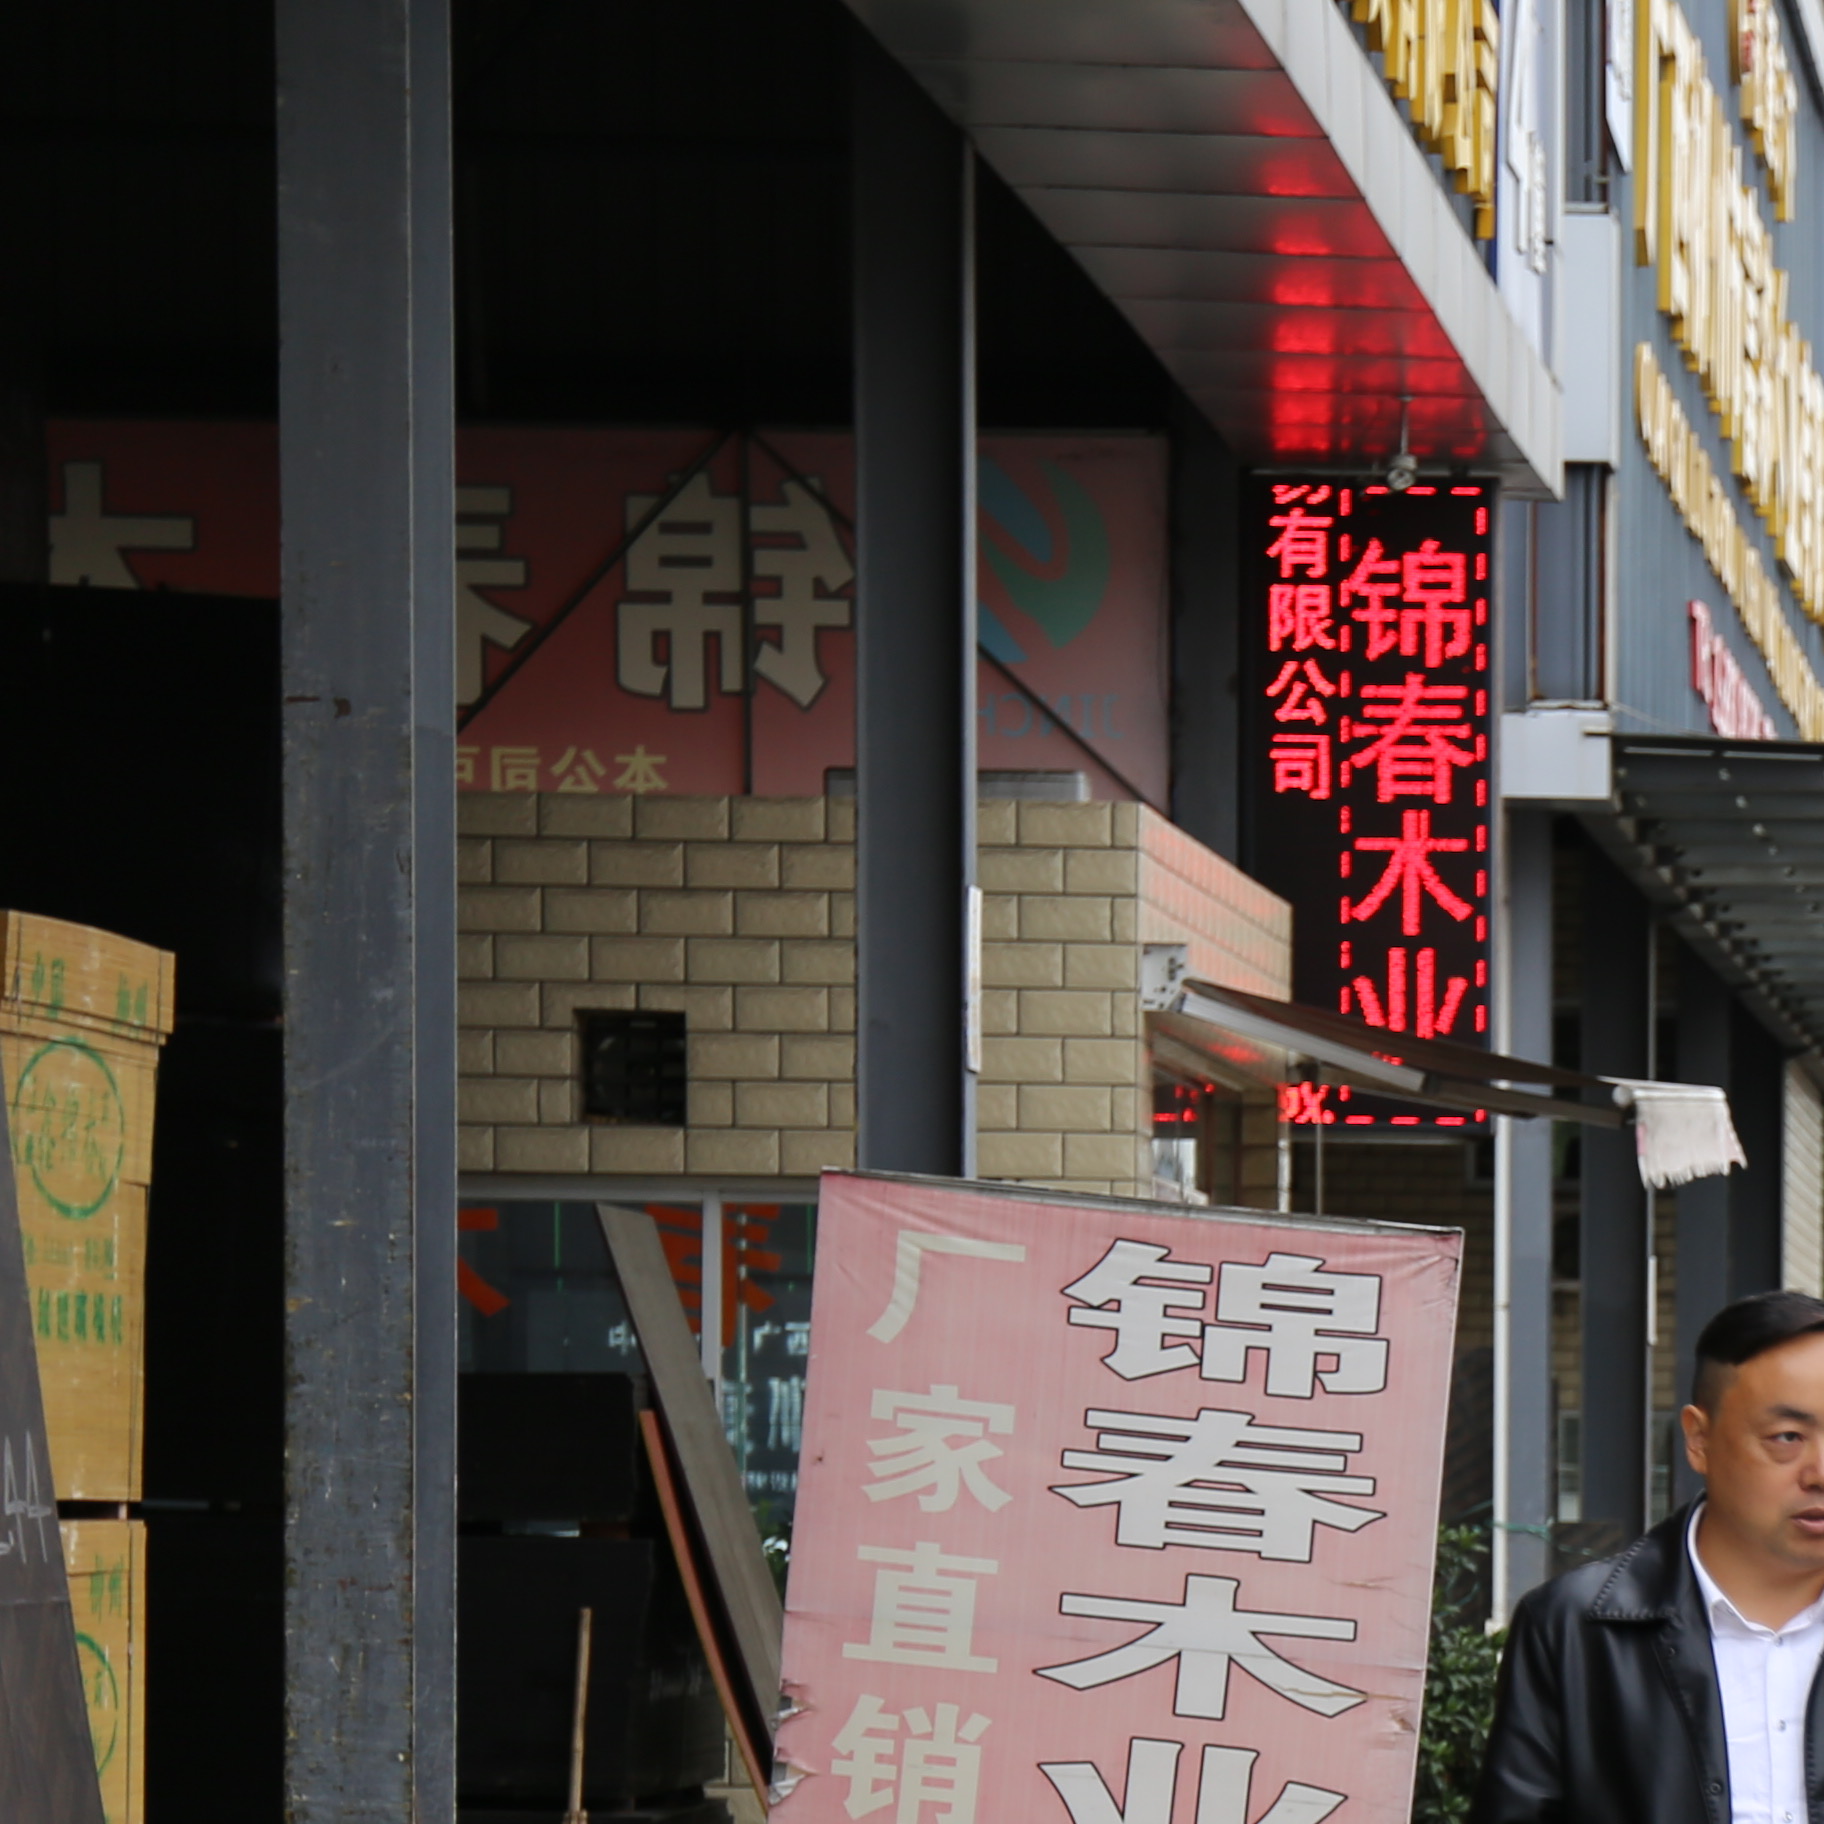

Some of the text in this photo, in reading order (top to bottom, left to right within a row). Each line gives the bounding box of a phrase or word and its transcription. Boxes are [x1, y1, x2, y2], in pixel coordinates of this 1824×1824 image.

[1266, 485, 1337, 800] 有限公司
[1349, 538, 1475, 1064] 锦春木业
